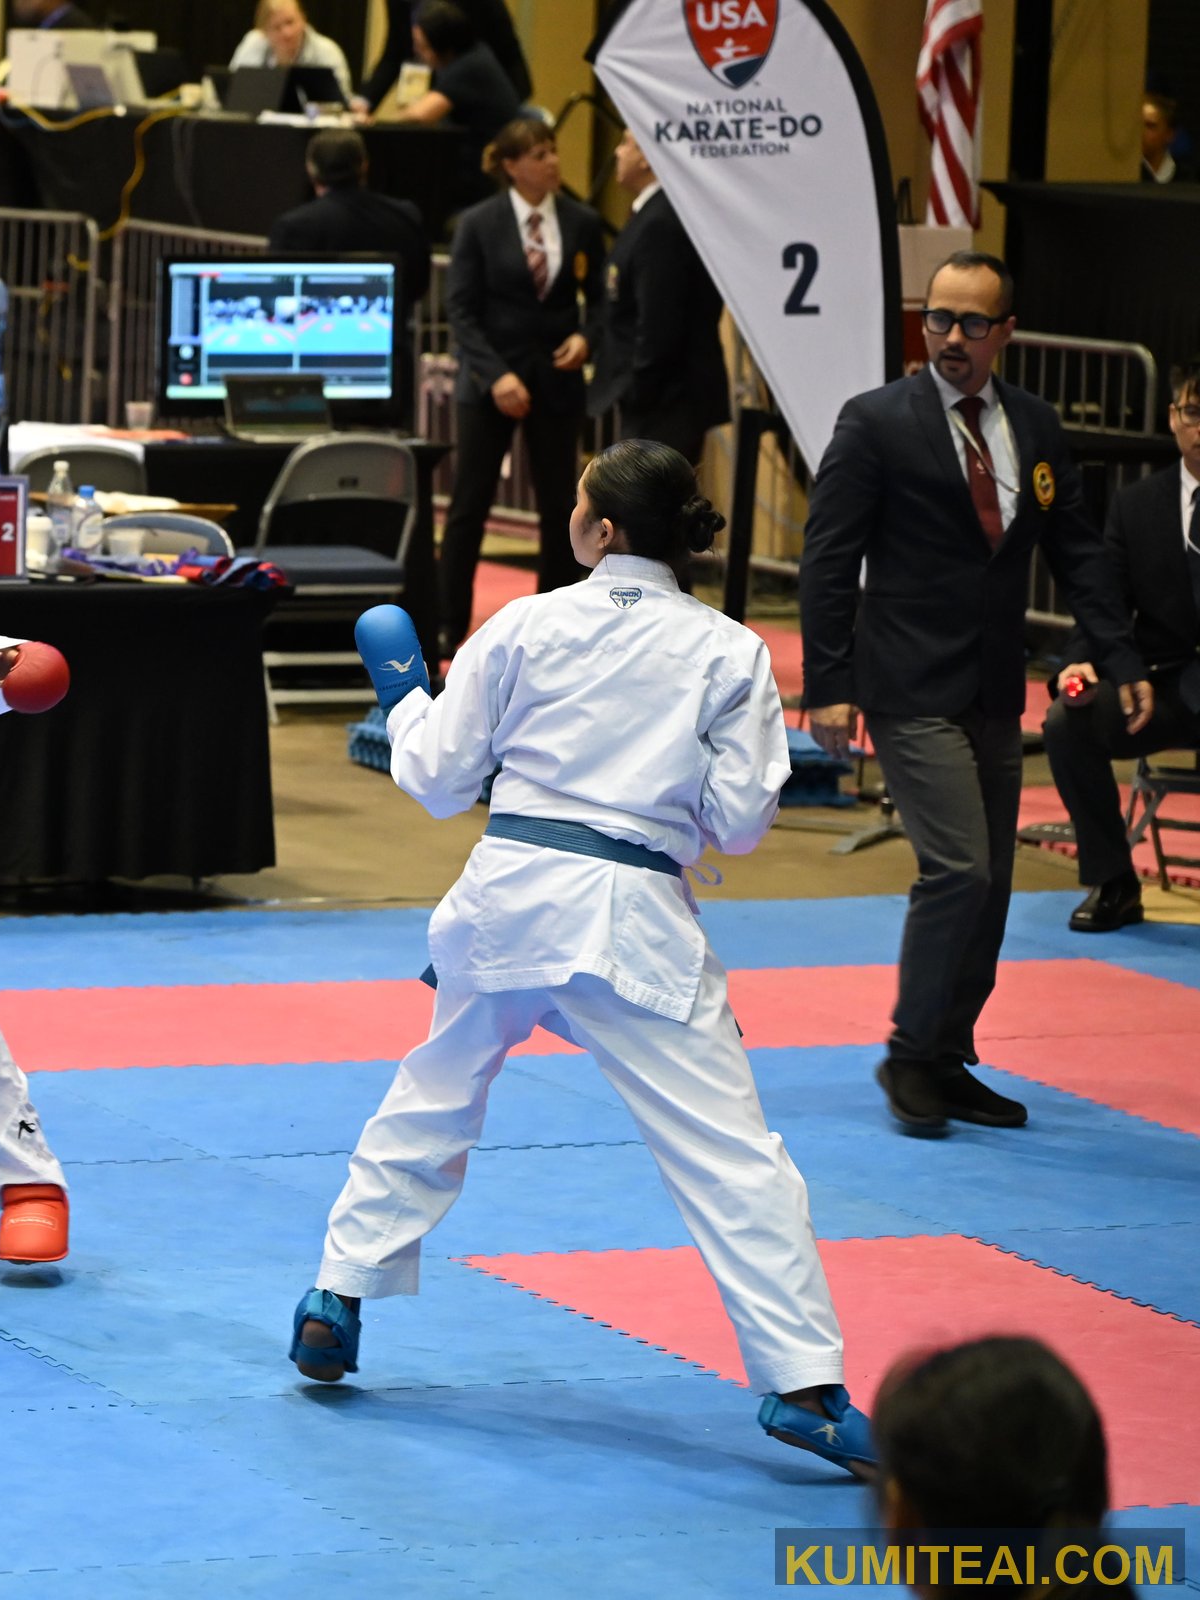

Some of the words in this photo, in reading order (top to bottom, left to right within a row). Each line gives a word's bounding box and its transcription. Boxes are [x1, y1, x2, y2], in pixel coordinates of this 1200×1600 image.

[695, 0, 769, 31] USA
[686, 98, 788, 116] NATIONAL
[655, 114, 823, 144] KARATE-DO
[690, 141, 791, 159] FEDERATION
[780, 241, 821, 316] 2
[1, 522, 15, 542] 2
